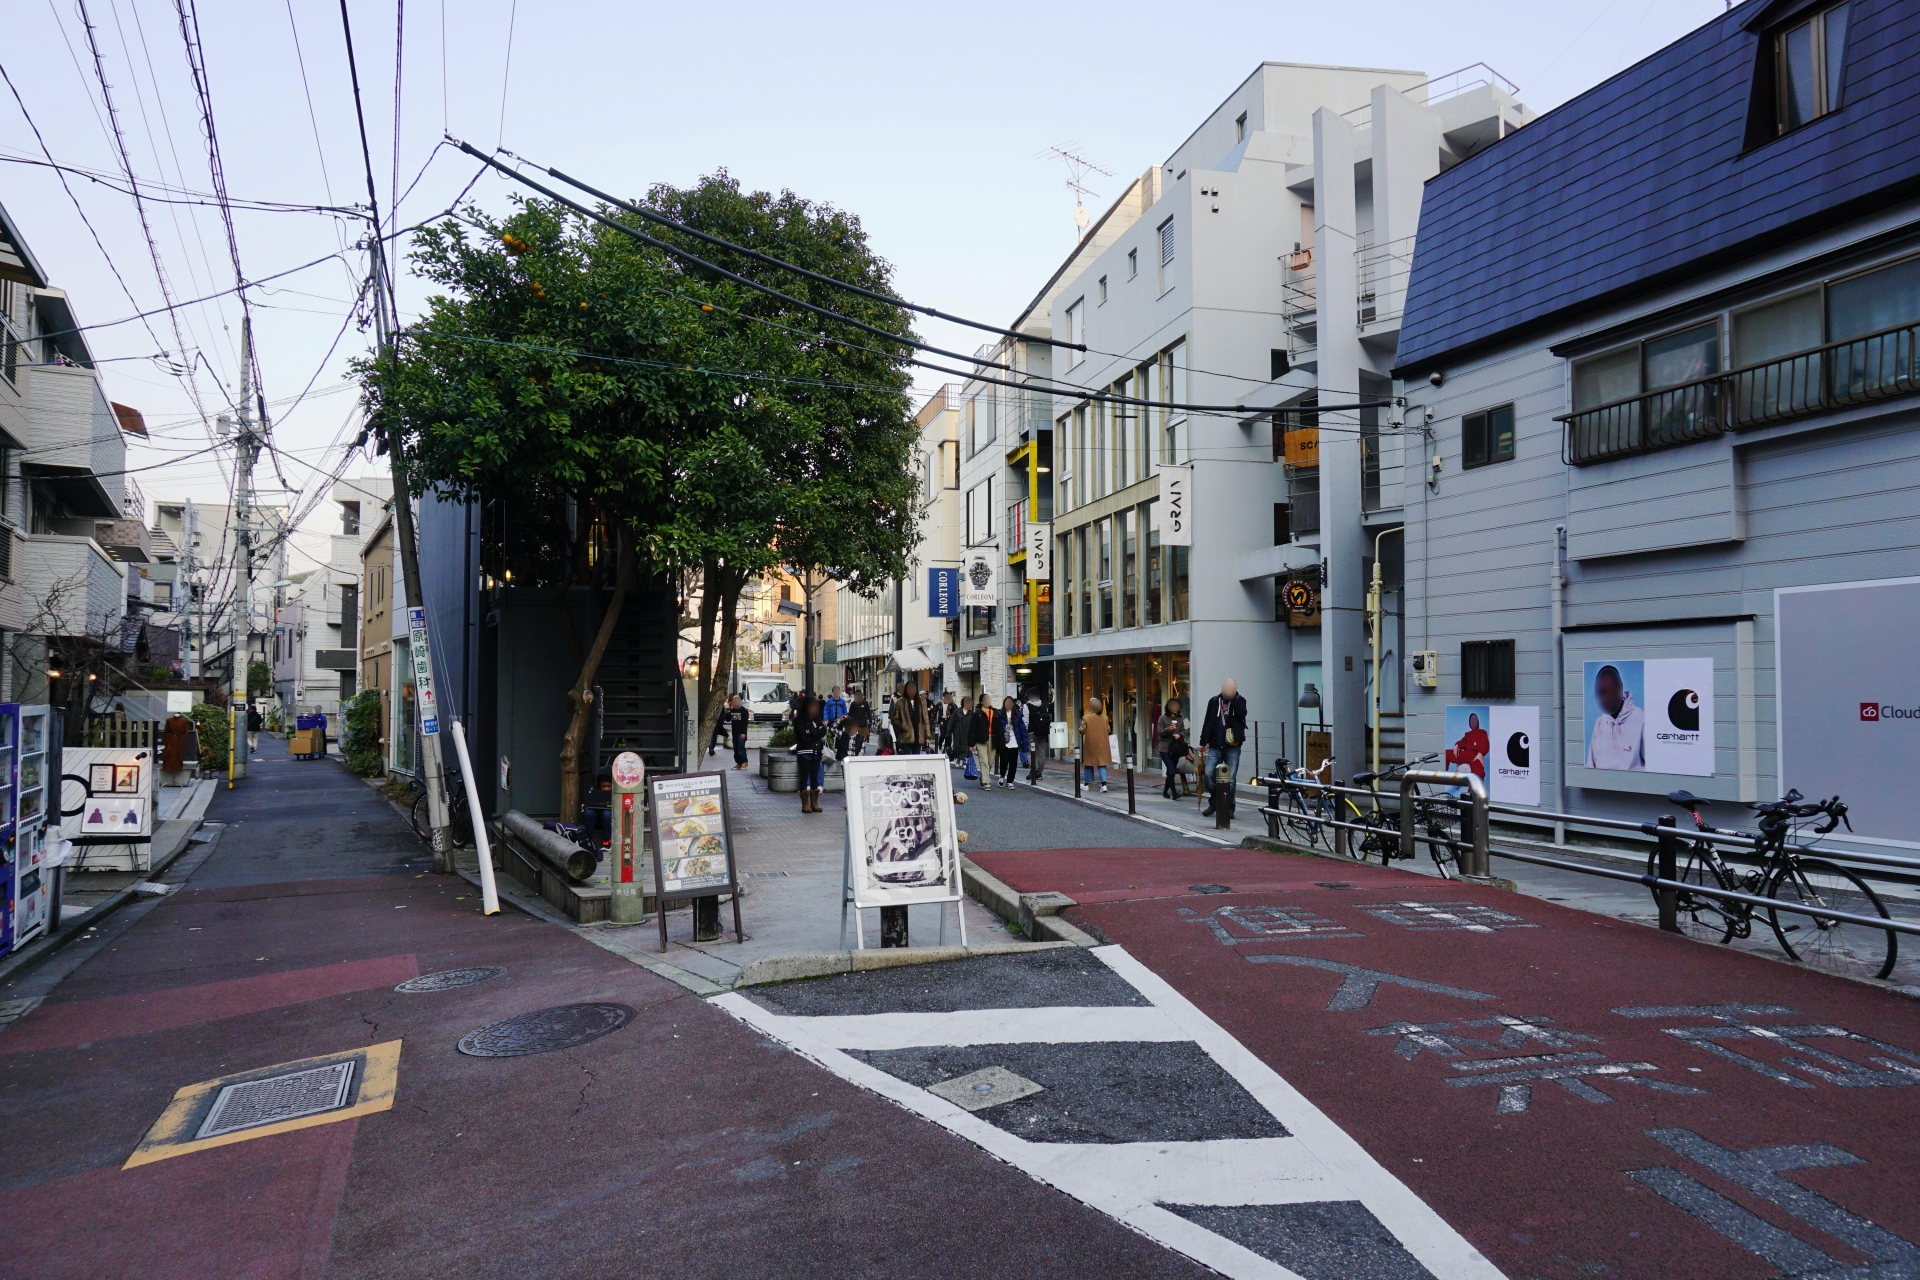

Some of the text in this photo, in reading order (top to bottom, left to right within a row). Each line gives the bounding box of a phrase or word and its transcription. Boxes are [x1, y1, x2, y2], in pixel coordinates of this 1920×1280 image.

[1170, 480, 1182, 533] GRAIN
[1035, 530, 1044, 570] GRAIN
[938, 571, 948, 614] CORLEONE
[966, 593, 995, 601] CORLEONE
[1656, 733, 1700, 741] carhartt
[1498, 768, 1530, 776] carhartt
[665, 791, 689, 799] LUNCH
[870, 787, 930, 807] DECADE
